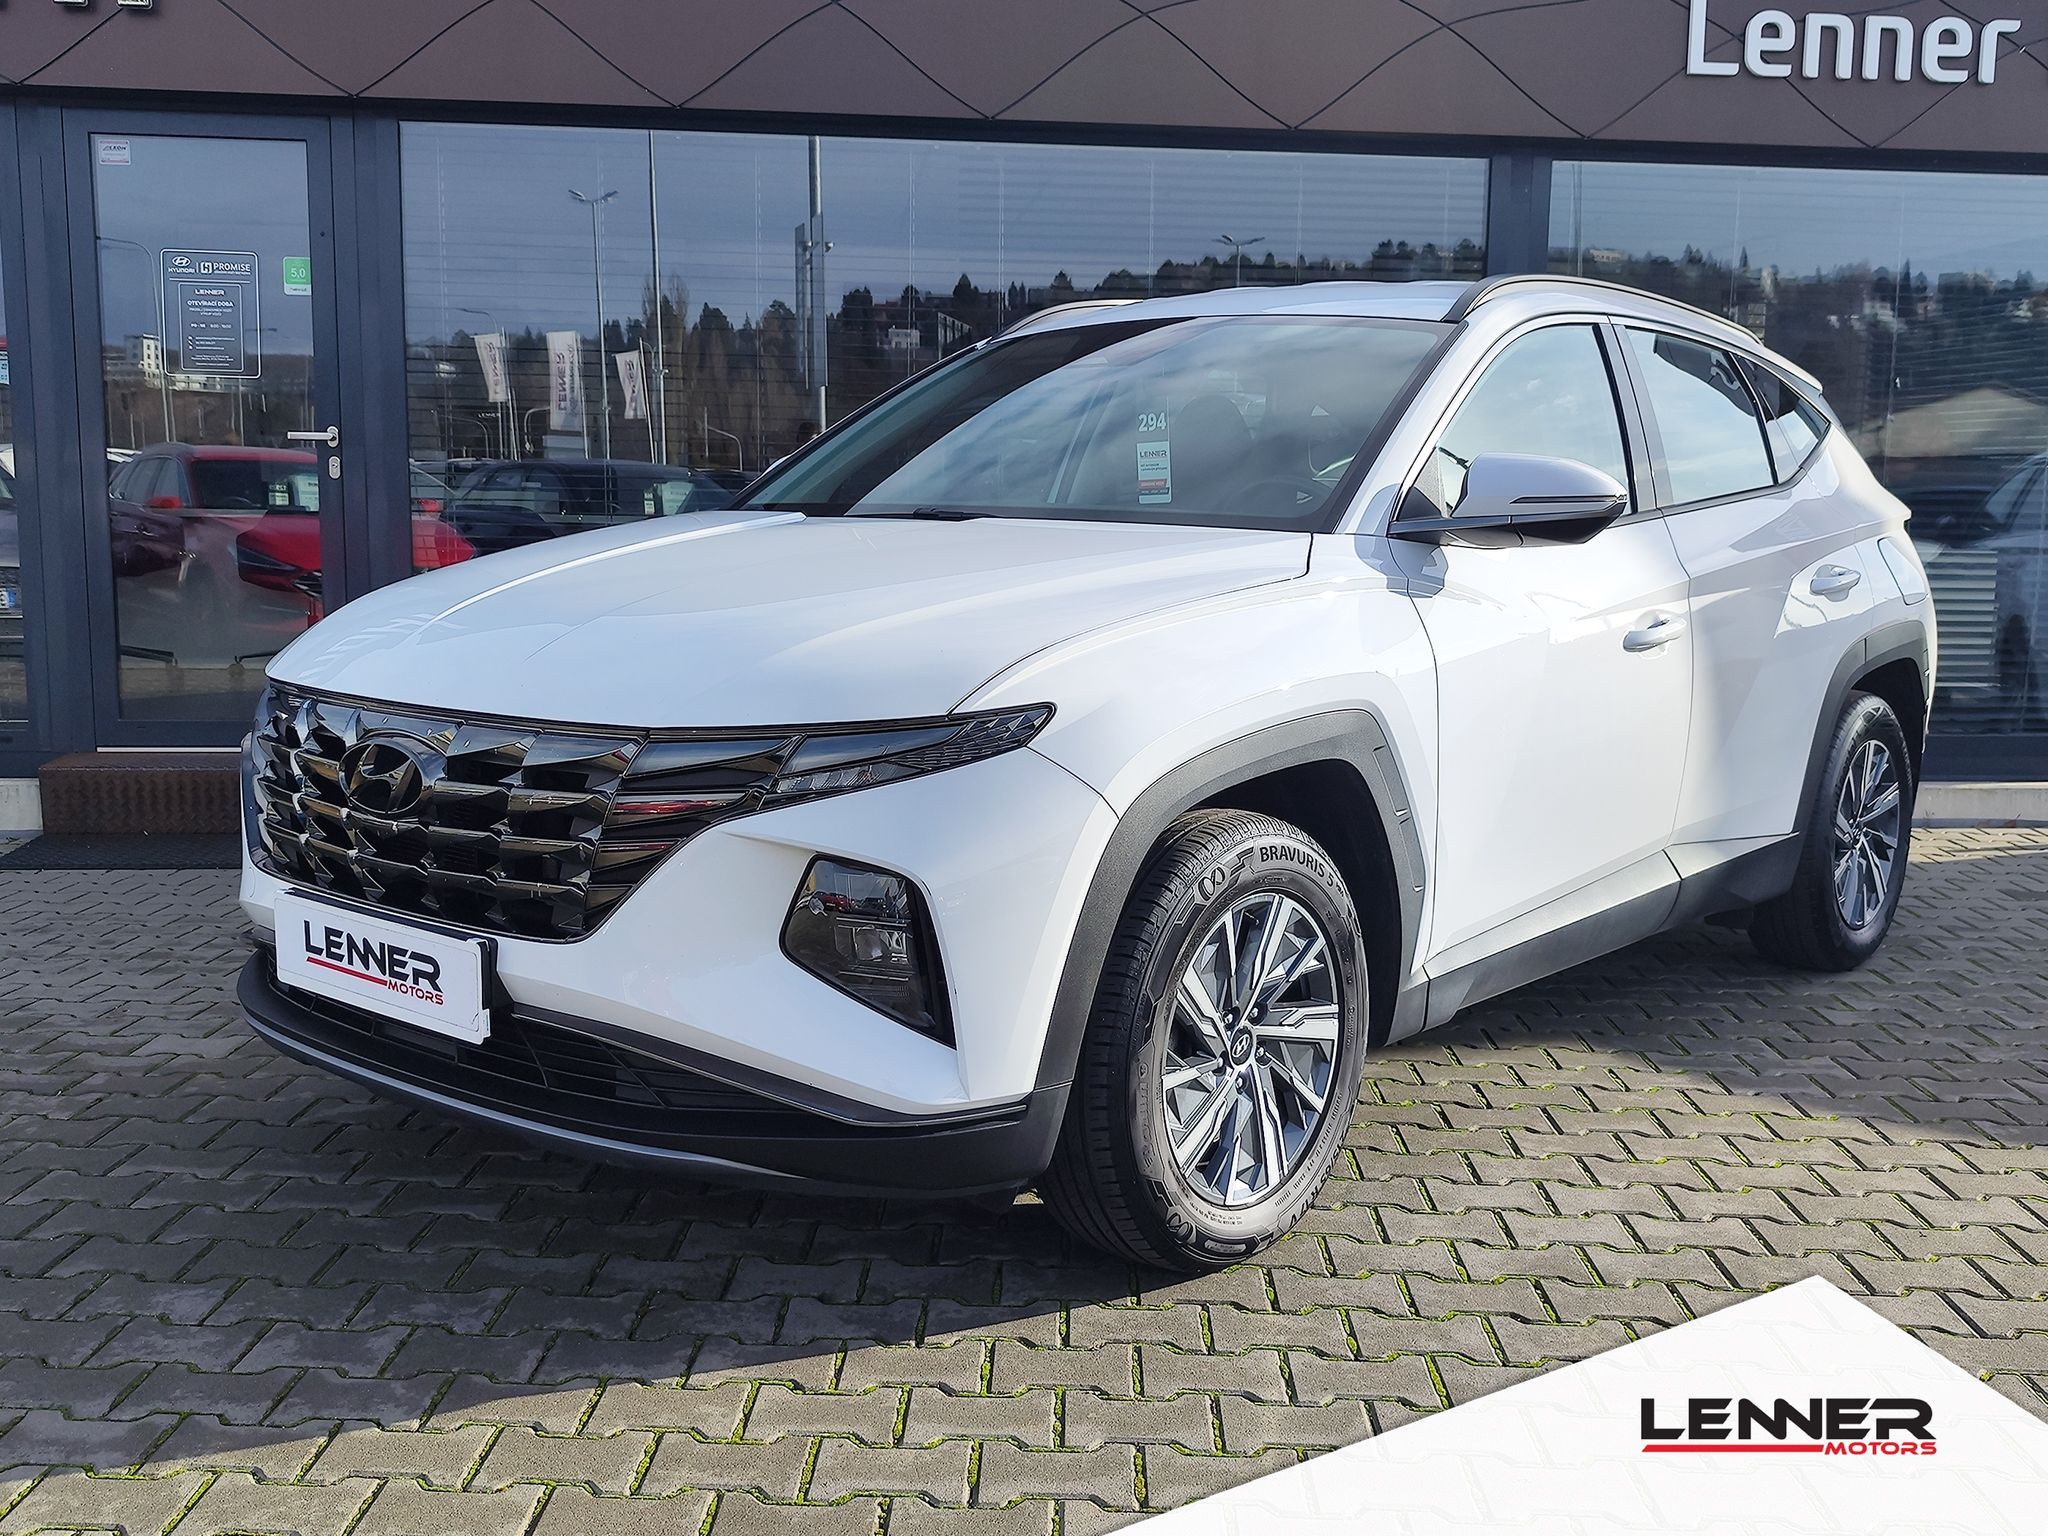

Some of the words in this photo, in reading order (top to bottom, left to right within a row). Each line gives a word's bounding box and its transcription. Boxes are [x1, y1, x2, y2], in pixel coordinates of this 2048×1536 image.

[1687, 0, 2021, 84] Lenner
[213, 262, 251, 272] PROMISE
[291, 267, 305, 278] 5,0
[1138, 412, 1166, 432] 294
[1260, 846, 1325, 878] BRAVURIS
[1326, 875, 1335, 887] 5
[303, 919, 443, 994] LENNER
[387, 979, 444, 1005] MOTORS
